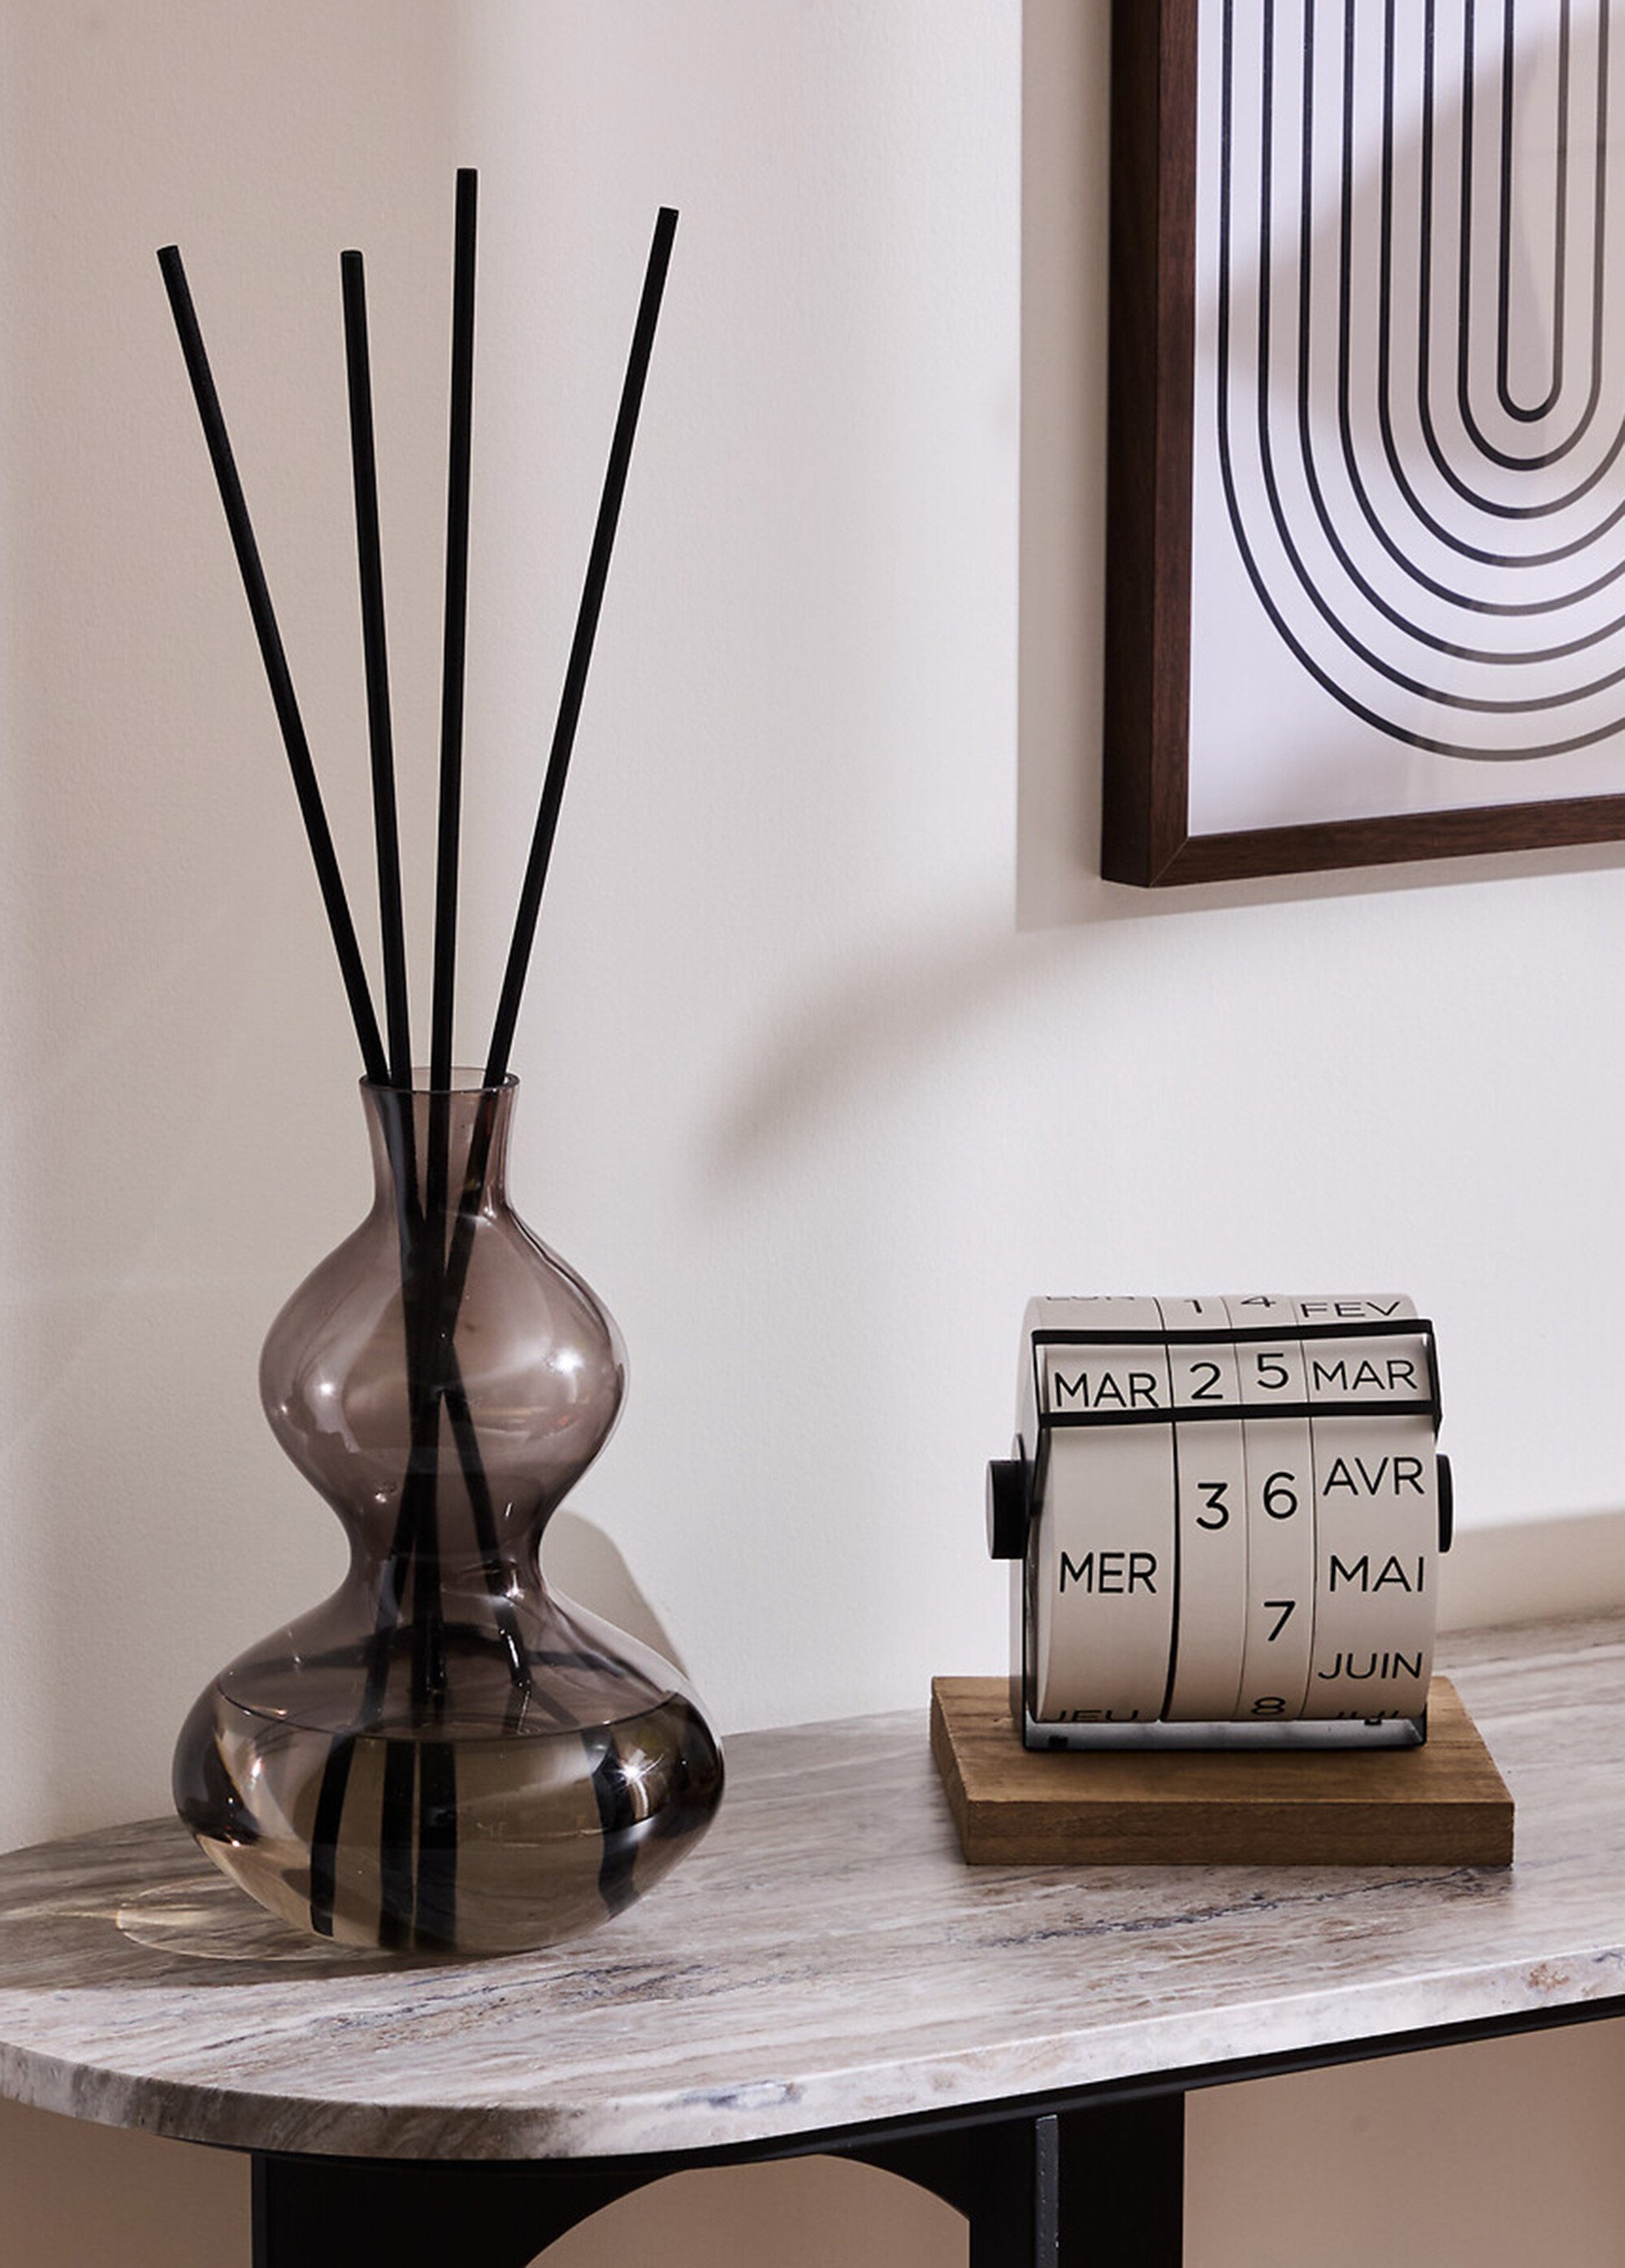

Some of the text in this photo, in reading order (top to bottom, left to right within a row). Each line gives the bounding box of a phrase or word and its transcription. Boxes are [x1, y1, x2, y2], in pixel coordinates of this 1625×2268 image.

[1240, 1296, 1276, 1307] 4
[1300, 1301, 1401, 1317] FEV
[1054, 1353, 1419, 1407] MAR 2 5 MAR
[1196, 1457, 1424, 1529] 3 6 AVR
[1060, 1552, 1156, 1594] MER
[1330, 1555, 1424, 1592] MAI
[1264, 1601, 1295, 1641] 7
[1318, 1653, 1422, 1680] JUIN
[1252, 1697, 1286, 1716] 8
